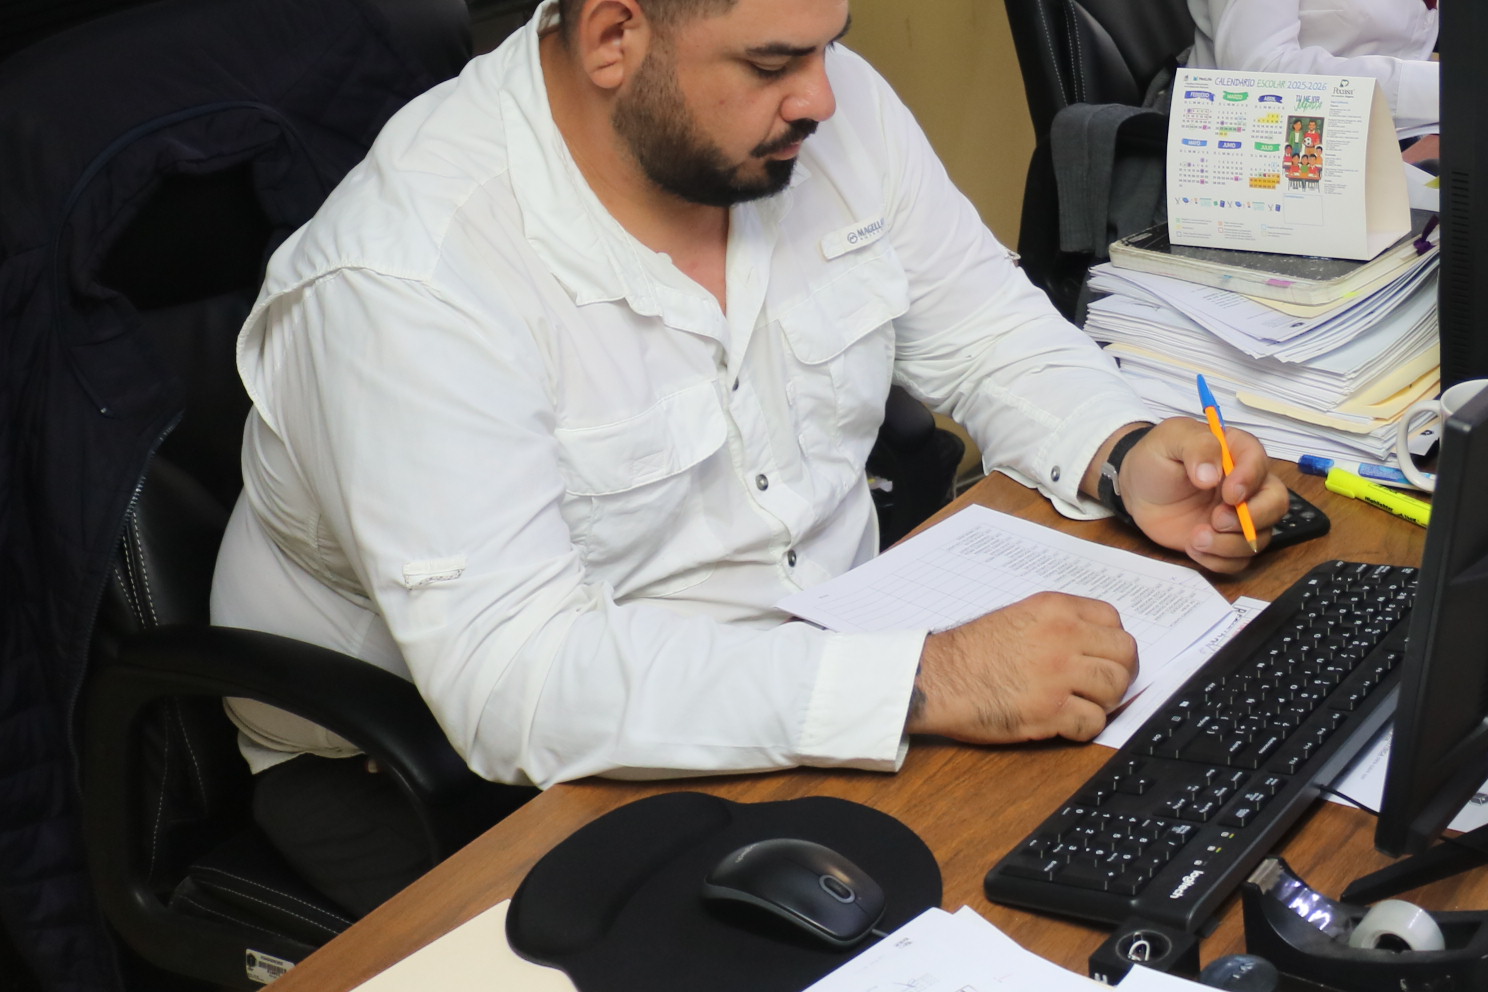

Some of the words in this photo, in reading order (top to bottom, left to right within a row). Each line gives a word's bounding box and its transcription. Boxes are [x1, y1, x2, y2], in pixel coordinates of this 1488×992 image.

[1214, 77, 1256, 87] CALENDARIO
[1256, 79, 1286, 89] ESCOLAR
[1287, 80, 1328, 91] 2025-2026
[1170, 870, 1204, 898] logitech
